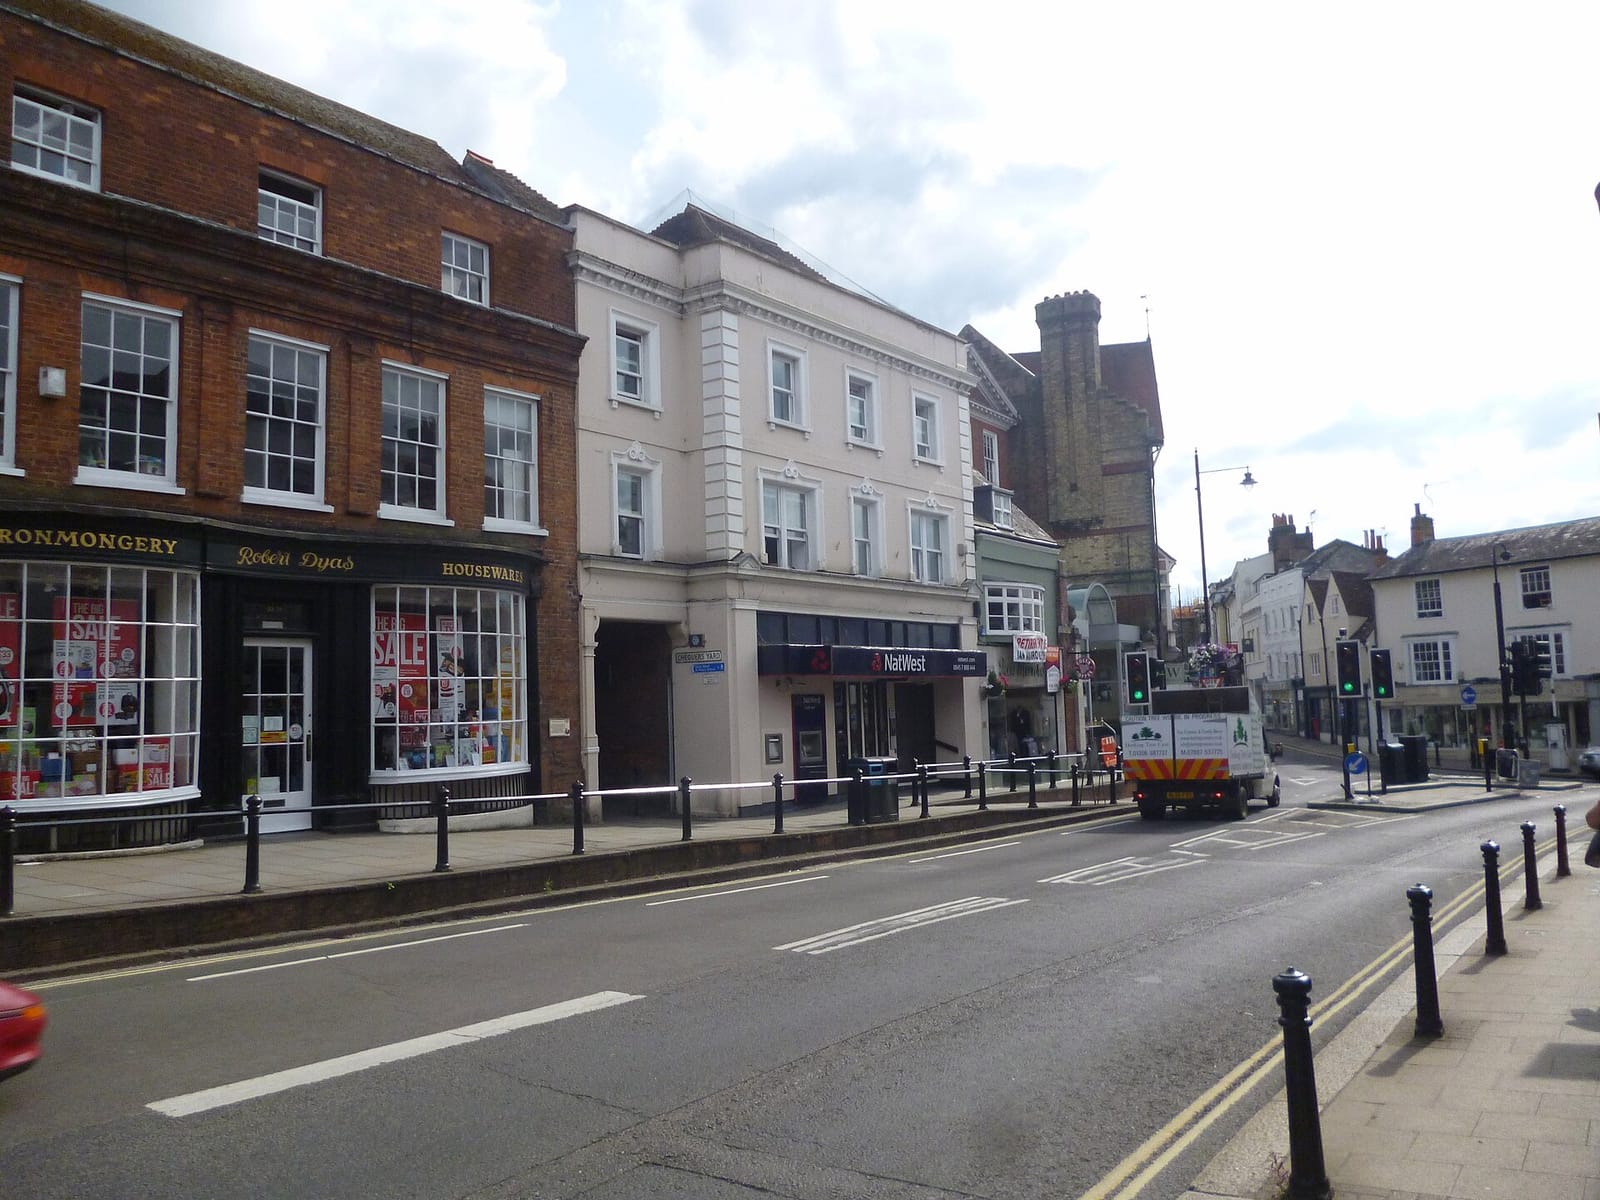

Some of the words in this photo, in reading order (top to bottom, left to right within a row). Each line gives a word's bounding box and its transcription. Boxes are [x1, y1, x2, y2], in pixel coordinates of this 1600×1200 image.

[237, 546, 290, 565] Robert
[299, 552, 355, 572] Dyas
[442, 563, 525, 583] HOUSEWARES
[72, 615, 121, 640] SALE
[391, 616, 406, 631] BG
[374, 632, 425, 665] SALE
[884, 653, 926, 672] NatWest
[148, 772, 174, 786] SALE
